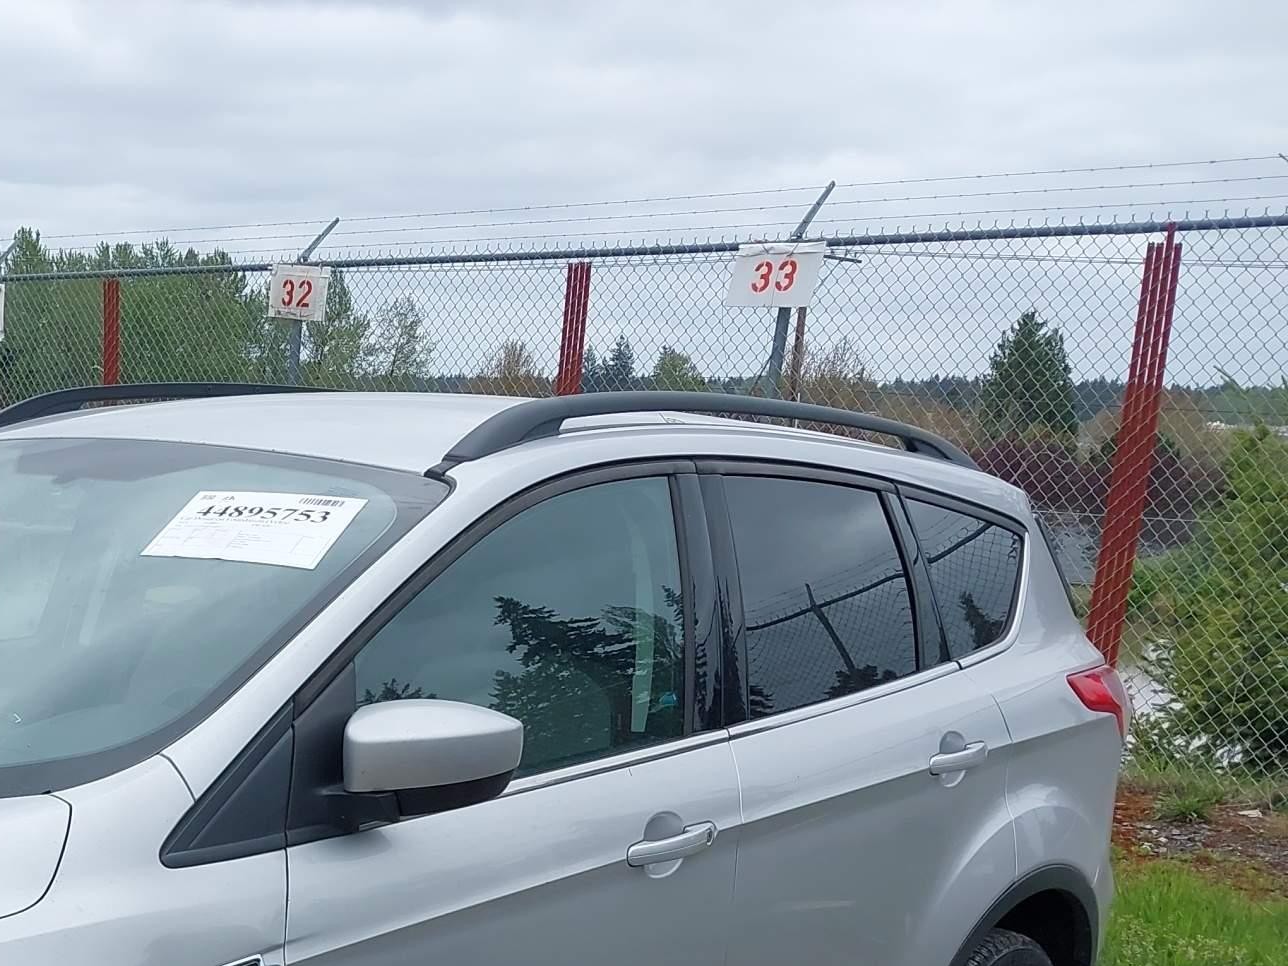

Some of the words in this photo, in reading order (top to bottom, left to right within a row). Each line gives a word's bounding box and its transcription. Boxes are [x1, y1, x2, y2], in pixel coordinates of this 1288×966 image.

[751, 259, 798, 294] 33
[281, 279, 313, 308] 32
[197, 504, 331, 524] 44895753
